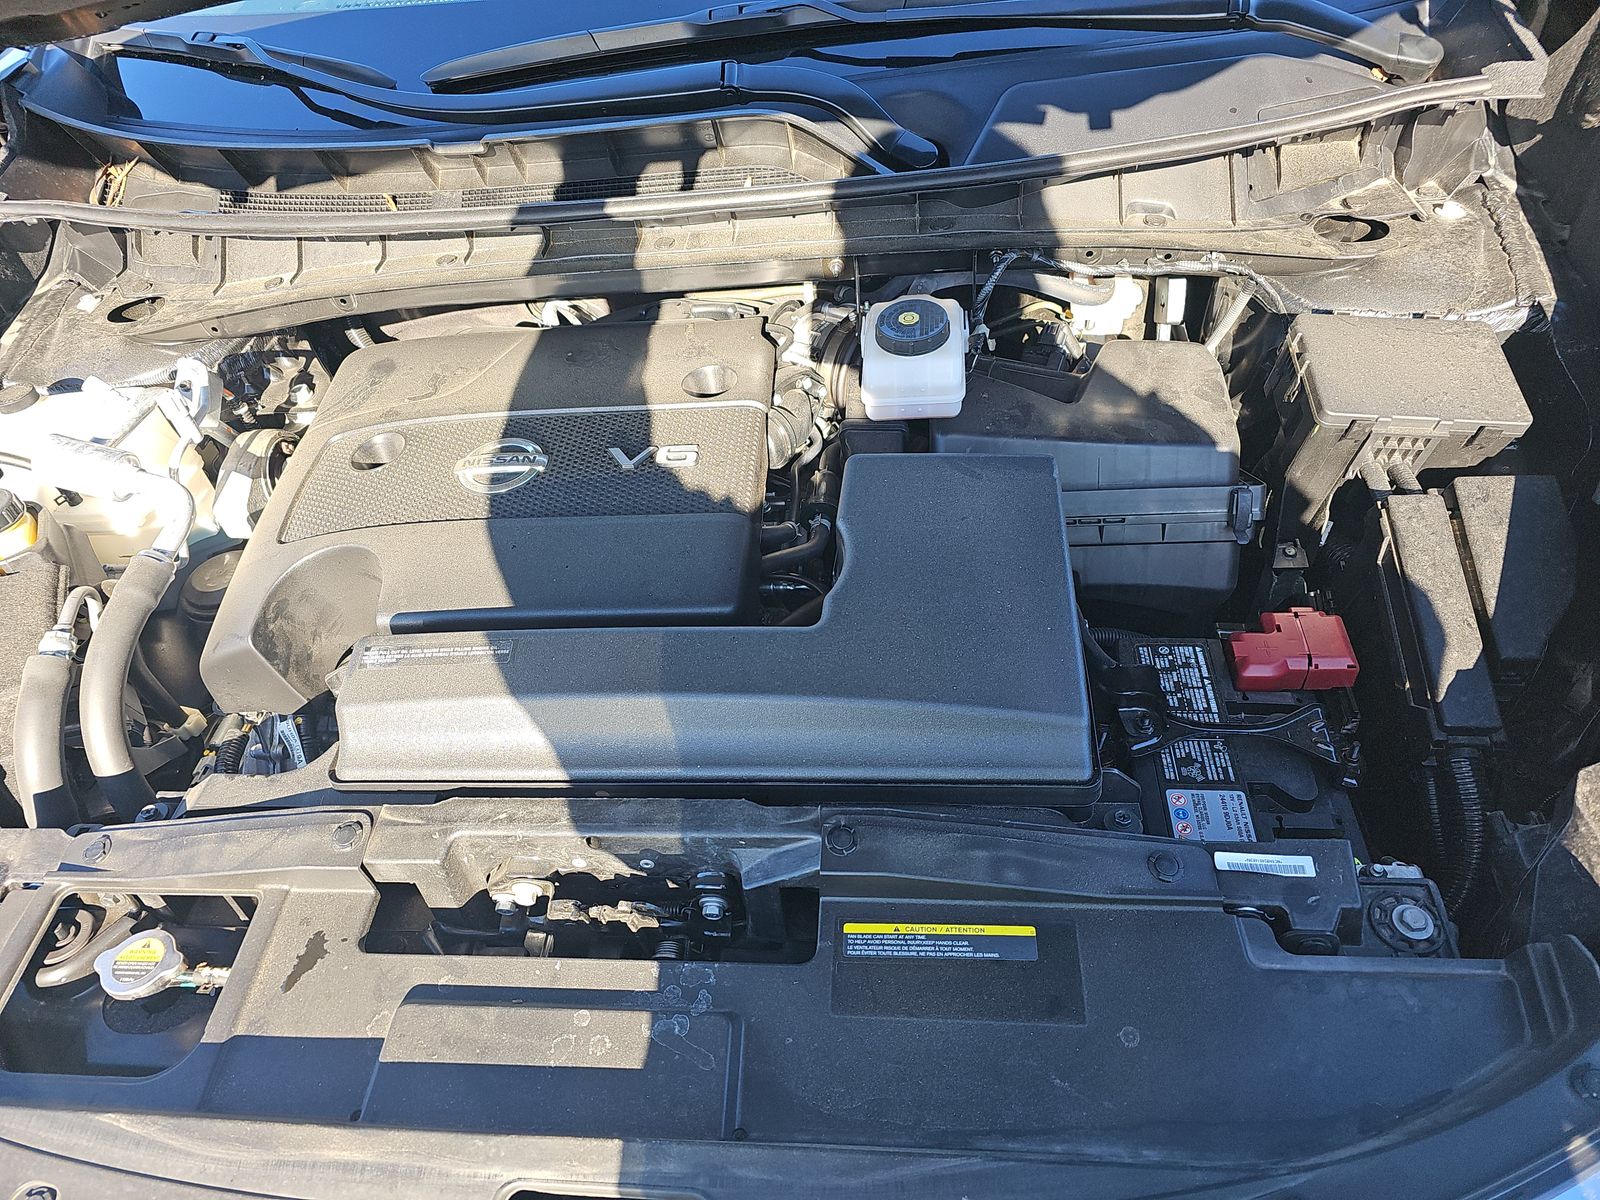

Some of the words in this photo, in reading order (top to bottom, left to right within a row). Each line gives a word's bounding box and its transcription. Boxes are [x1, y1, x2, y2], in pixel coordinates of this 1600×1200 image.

[462, 454, 537, 467] NISSAN
[608, 444, 701, 469] V6
[1219, 794, 1229, 811] 24410
[1237, 794, 1248, 820] RENAULT
